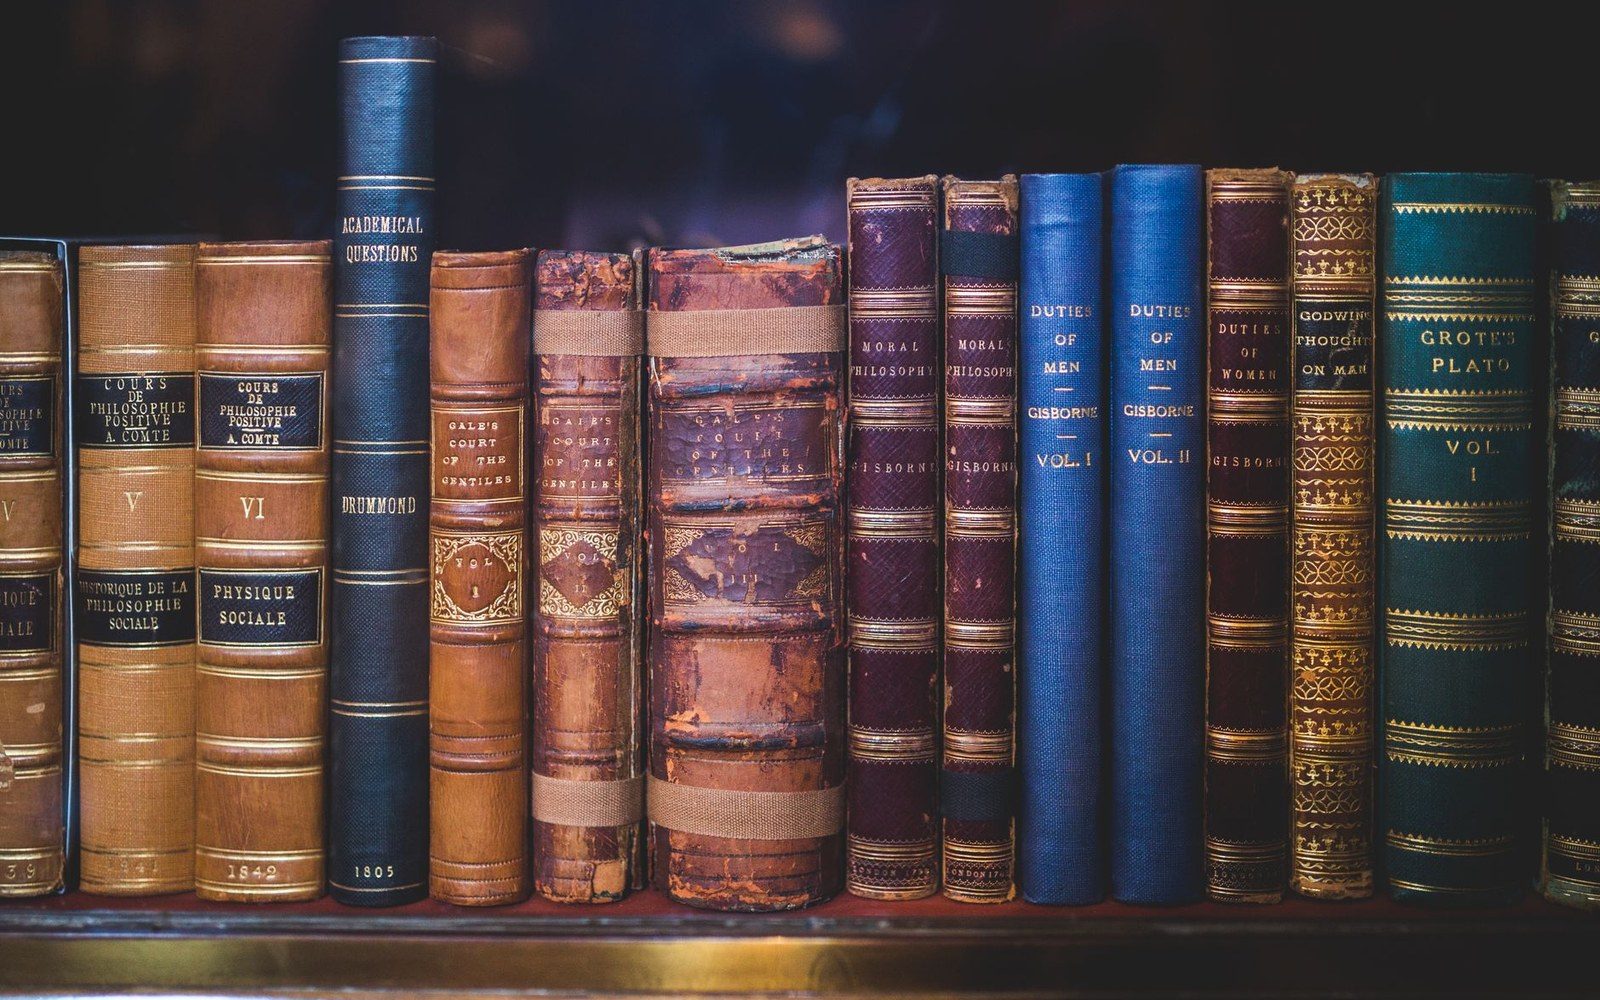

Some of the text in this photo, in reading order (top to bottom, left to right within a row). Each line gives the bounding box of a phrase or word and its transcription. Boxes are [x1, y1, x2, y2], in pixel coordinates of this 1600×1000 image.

[342, 216, 423, 234] ACADEMICAL
[346, 246, 418, 263] QUESTIONS
[1031, 305, 1092, 318] DUTIES
[1130, 304, 1191, 318] DUTIES
[1219, 323, 1281, 335] DUTIES
[1055, 334, 1077, 346] OF
[1150, 332, 1173, 344] OF
[1421, 330, 1515, 345] GROTE'S
[862, 342, 919, 352] MORAL
[958, 339, 1003, 350] MORAL
[1240, 348, 1258, 359] OF
[1044, 361, 1080, 373] MEN
[1140, 359, 1177, 371] MEN
[1302, 364, 1367, 375] ON MAN
[1432, 358, 1509, 373] PLATO
[1222, 369, 1277, 380] WOMEN
[104, 378, 167, 390] COURS
[238, 382, 279, 393] COURS
[128, 390, 144, 402] DE
[247, 393, 263, 404] DE
[90, 402, 186, 415] PHILOSOPHIE
[220, 405, 297, 416] PHILOSOPHIE
[1028, 406, 1098, 419] GISBORNE
[1124, 404, 1194, 417] GISBORNE
[105, 414, 171, 427] POSITIVE
[228, 416, 282, 427] POSITIVE
[448, 421, 498, 431] GALE'S
[105, 430, 170, 443] A. COMTE
[227, 434, 280, 445] A. COMTE
[553, 437, 611, 446] COURT
[449, 438, 497, 448] COURT
[1446, 440, 1499, 454] VOL.
[443, 455, 506, 465] OF THE
[692, 448, 790, 460] OF THE
[1037, 452, 1092, 468] VOL. I
[1128, 449, 1190, 464] VOL. II
[547, 458, 614, 467] OF THE
[1471, 467, 1476, 481] I
[442, 475, 512, 486] GENTILES
[124, 492, 143, 512] V
[239, 497, 265, 519] VI
[342, 496, 416, 514] DRUMMOND
[564, 552, 600, 561] VOL
[455, 558, 493, 569] VOL
[148, 582, 164, 594] DE
[172, 580, 188, 593] LA
[213, 585, 295, 600] PHYSIQUE
[87, 598, 181, 612] PHILOSOPHIE
[109, 617, 159, 630] SOCIALE
[219, 611, 286, 625] SOCIALE
[227, 865, 277, 880] 1842
[355, 866, 394, 878] 1805
